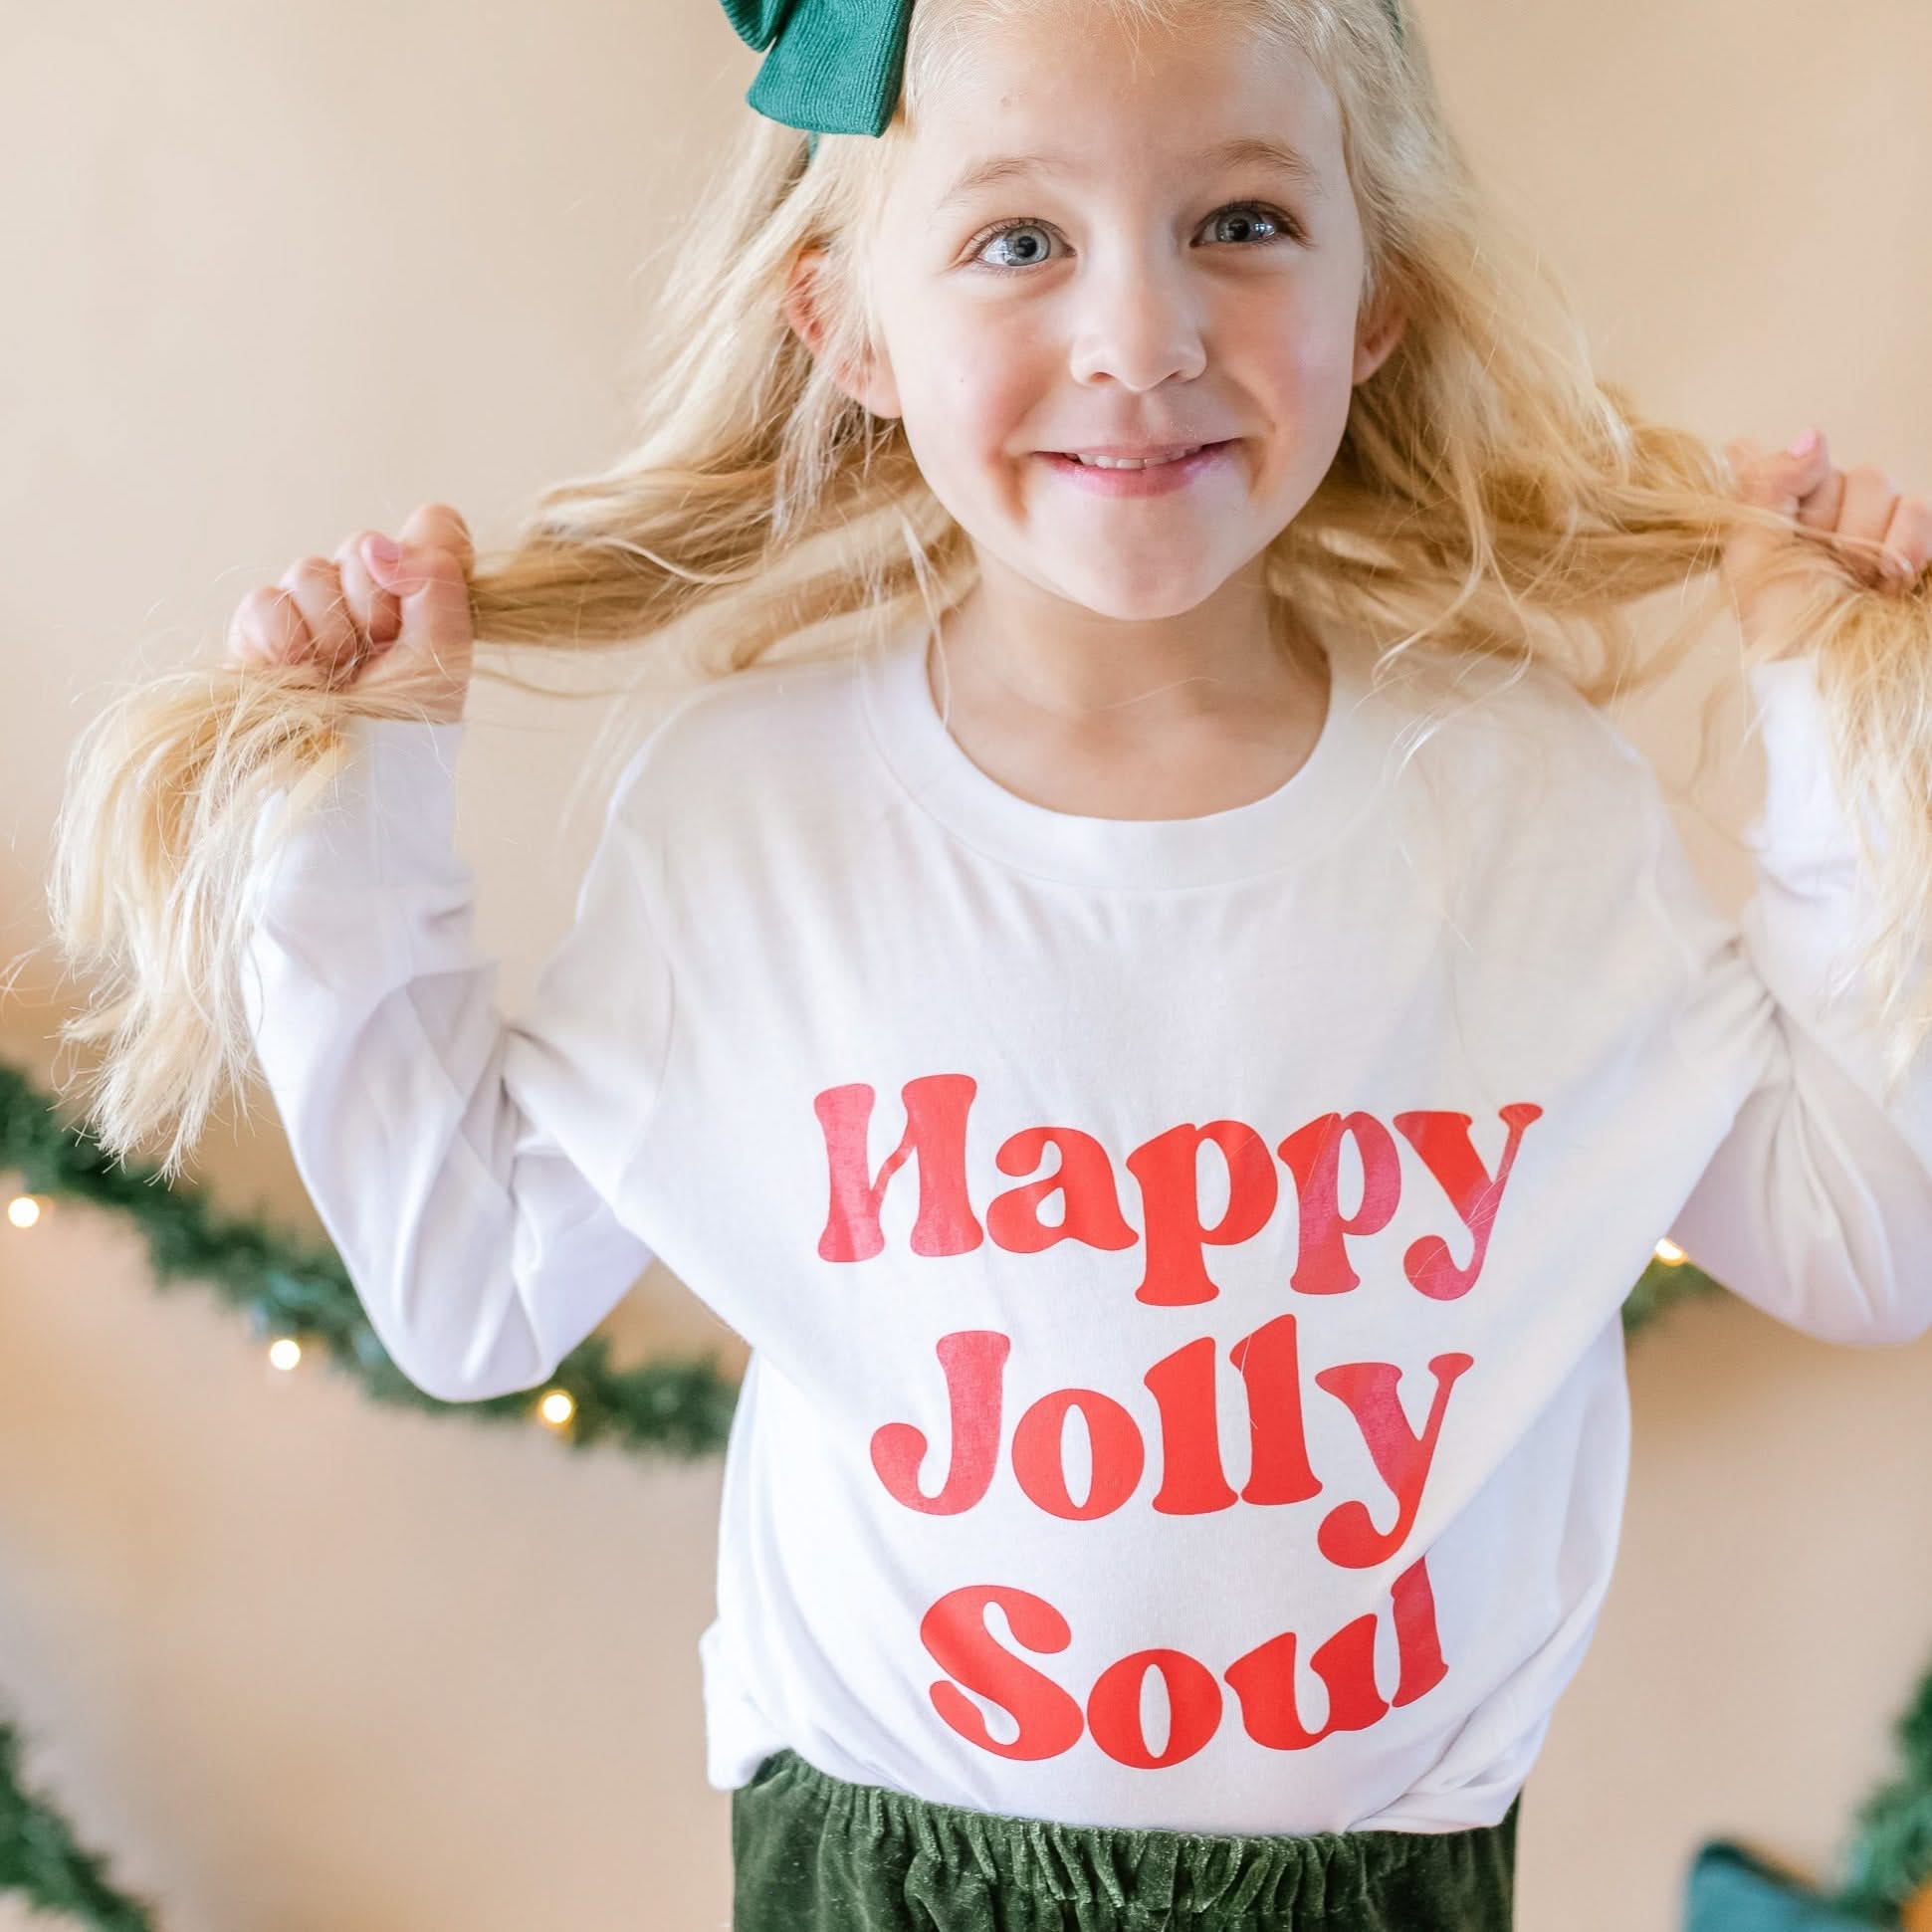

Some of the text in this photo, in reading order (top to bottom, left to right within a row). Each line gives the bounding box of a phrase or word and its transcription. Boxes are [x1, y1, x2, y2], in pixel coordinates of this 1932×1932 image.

[813, 1073, 1543, 1306] Happy
[870, 1314, 1473, 1570] Jolly
[920, 1557, 1449, 1770] Soul
